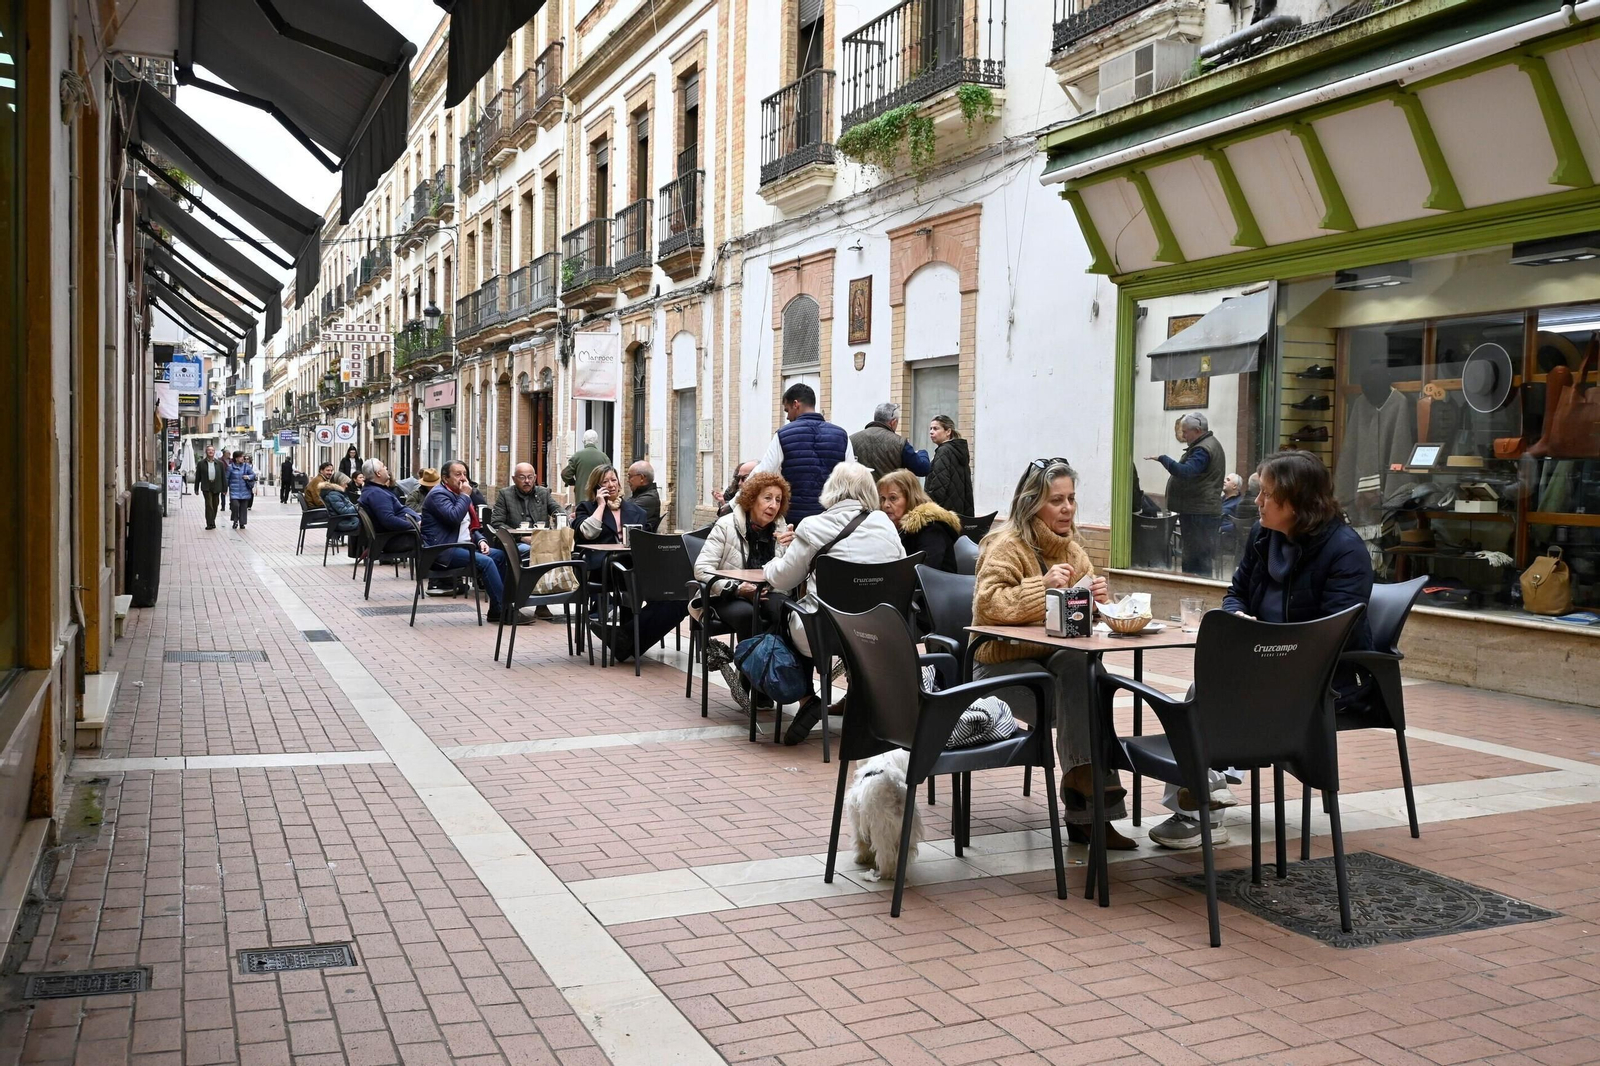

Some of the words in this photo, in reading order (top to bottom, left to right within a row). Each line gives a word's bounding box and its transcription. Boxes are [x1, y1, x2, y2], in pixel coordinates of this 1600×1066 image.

[333, 324, 379, 332] FOTO
[321, 333, 390, 342] STUDIO
[1253, 644, 1298, 652] Cruzcampo
